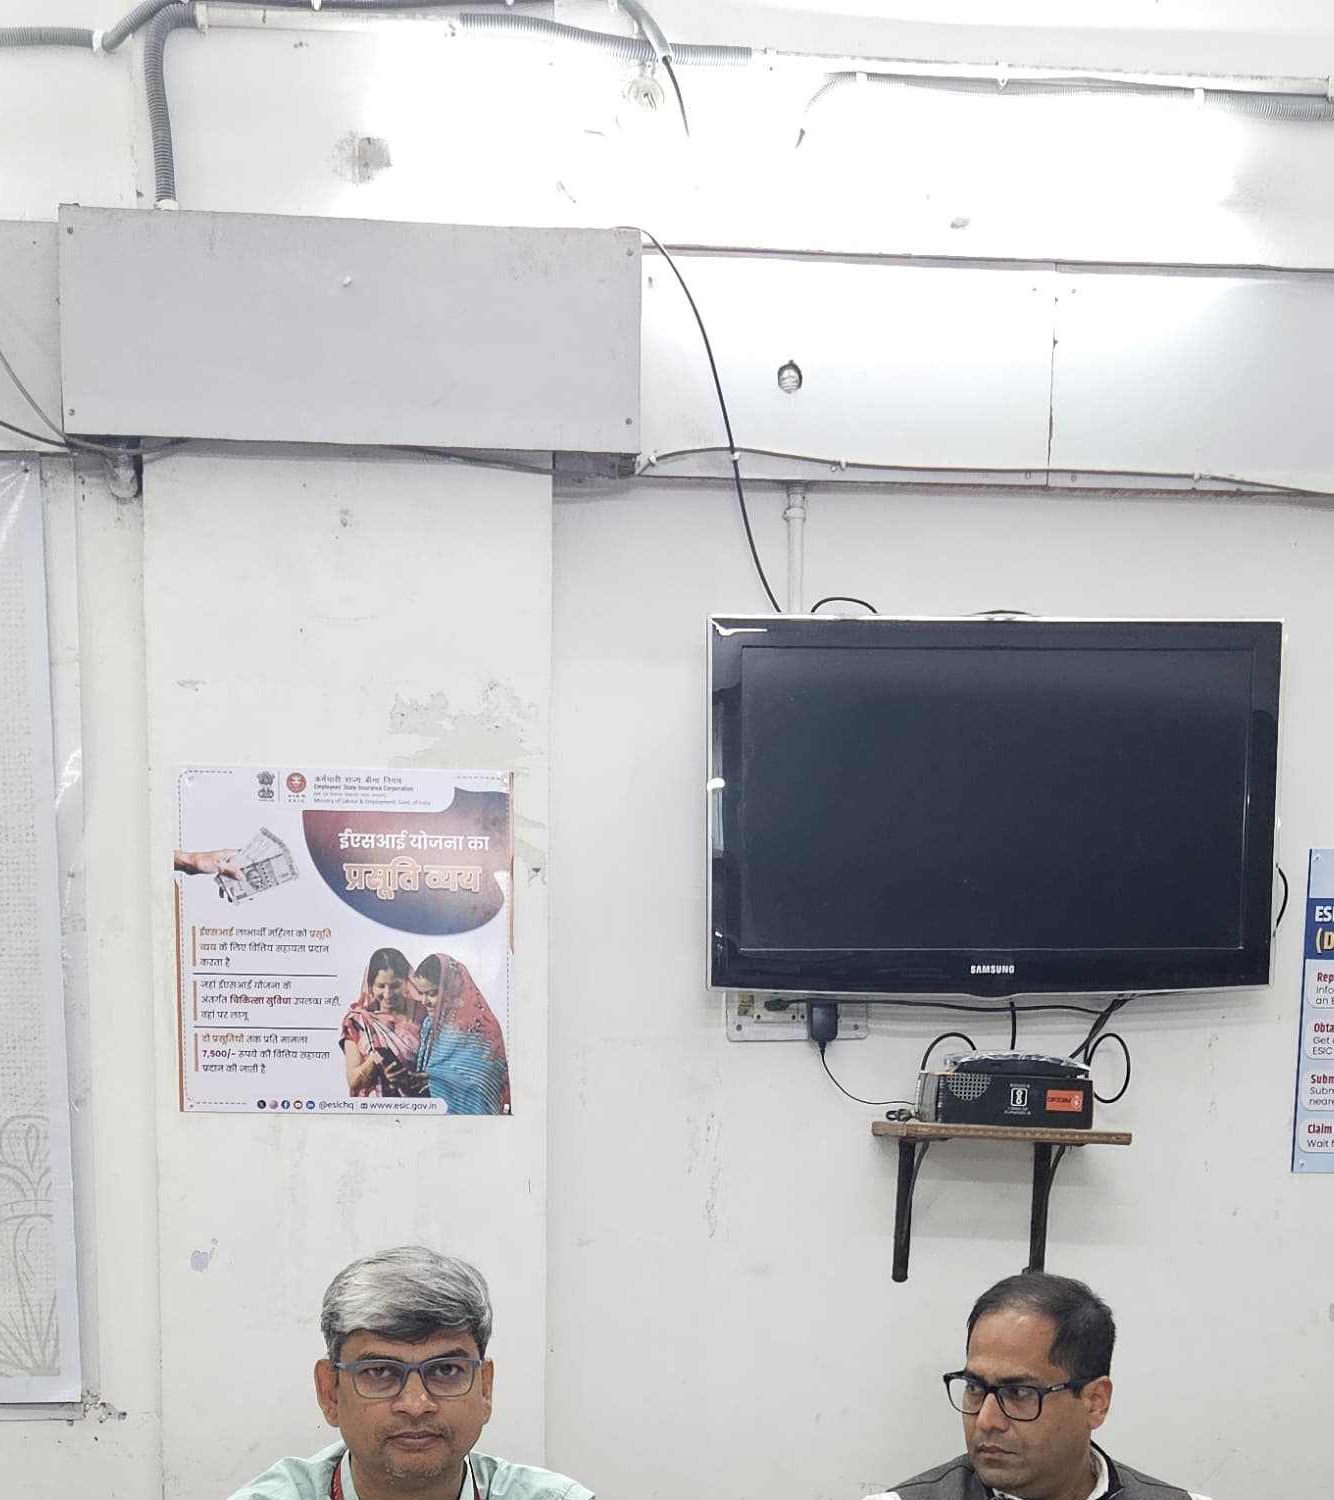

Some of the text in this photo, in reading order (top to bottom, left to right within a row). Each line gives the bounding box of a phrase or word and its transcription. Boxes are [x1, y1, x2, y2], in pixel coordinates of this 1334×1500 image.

[338, 829, 490, 851] ईएसआई योजना का
[342, 856, 483, 901] प्रसूति व्यय
[970, 964, 1015, 975] SAMSUNG
[1315, 997, 1329, 1005] an
[1313, 1036, 1330, 1045] Get
[202, 1049, 236, 1059] 7,500/-
[1312, 1047, 1333, 1056] ESIC
[319, 1100, 437, 1111] @esichq www.esic.gov.in
[1308, 1124, 1333, 1135] Claim
[1307, 1140, 1329, 1149] Wait
